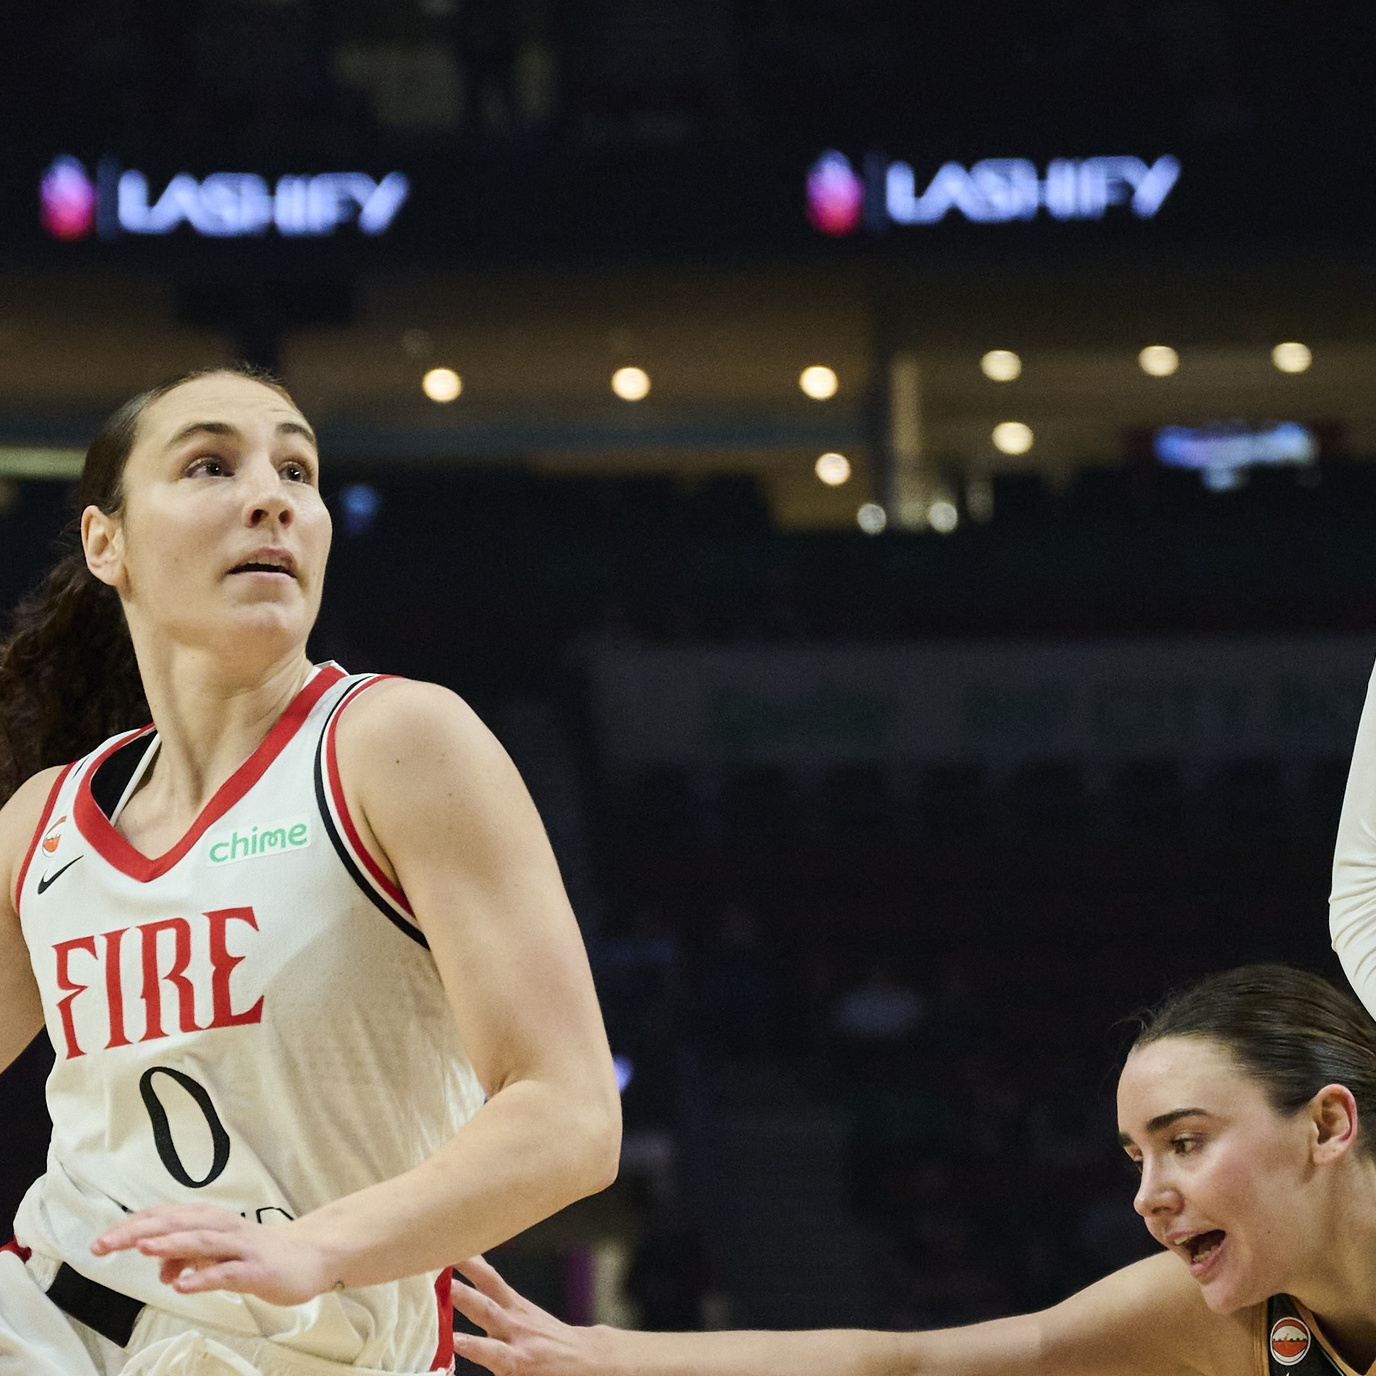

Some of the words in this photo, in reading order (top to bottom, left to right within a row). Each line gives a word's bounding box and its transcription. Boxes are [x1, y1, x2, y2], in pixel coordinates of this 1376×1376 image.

[118, 169, 409, 237] LASHIFY
[886, 153, 1181, 225] LASHIFY
[209, 823, 308, 863] chime
[52, 906, 265, 1060] FIRE
[140, 1066, 231, 1189] 0
